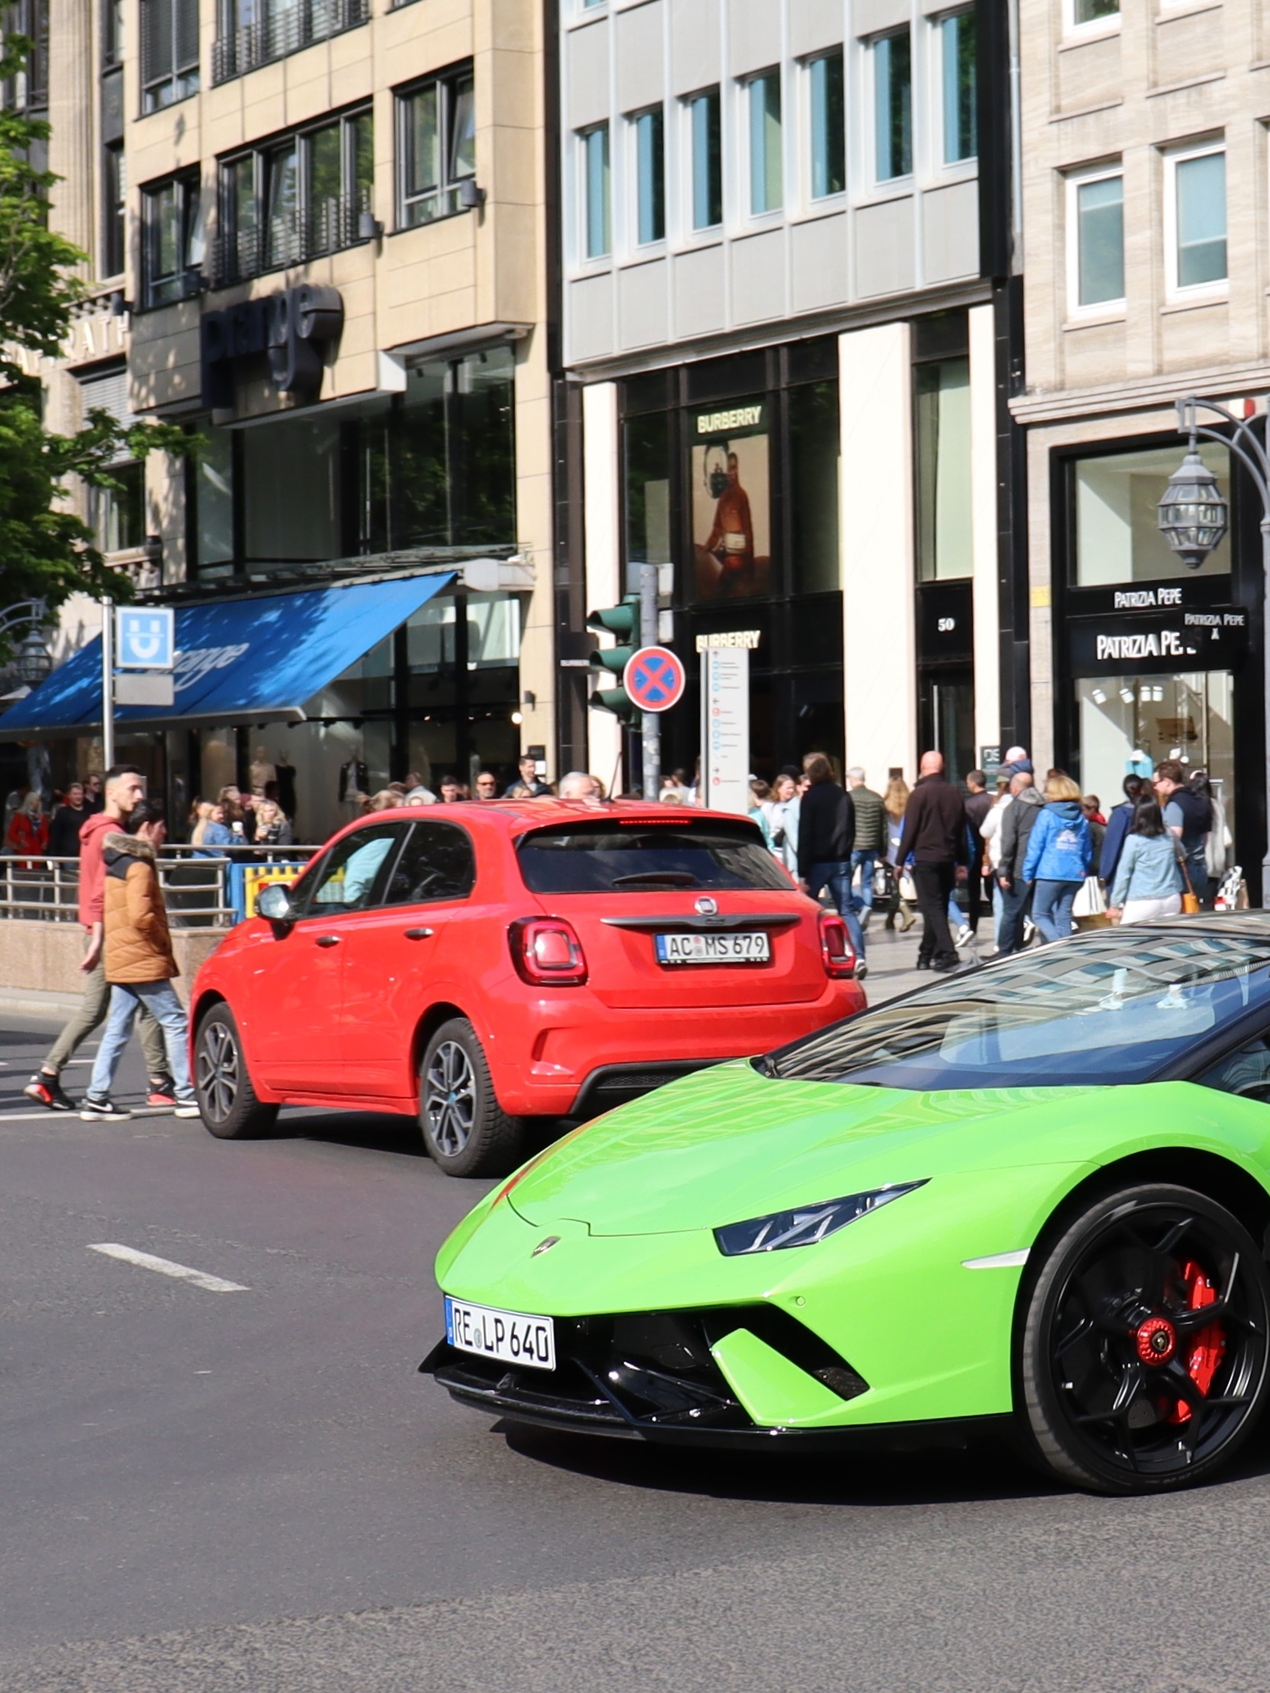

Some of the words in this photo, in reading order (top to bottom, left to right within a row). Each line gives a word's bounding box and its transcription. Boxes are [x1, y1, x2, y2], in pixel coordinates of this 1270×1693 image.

[697, 405, 762, 434] BURBERRY
[1114, 591, 1156, 609] PATRIZIA
[1157, 588, 1182, 605] PEPE
[938, 618, 955, 631] 50
[1184, 613, 1222, 626] PATRIZIA
[1223, 613, 1245, 626] PEPE
[1096, 634, 1160, 660] PATRIZIA
[669, 937, 691, 956] AC
[704, 937, 729, 956] MS
[732, 935, 765, 955] 679
[454, 1307, 473, 1346] RE
[482, 1315, 505, 1353] LP
[510, 1322, 549, 1362] 640
